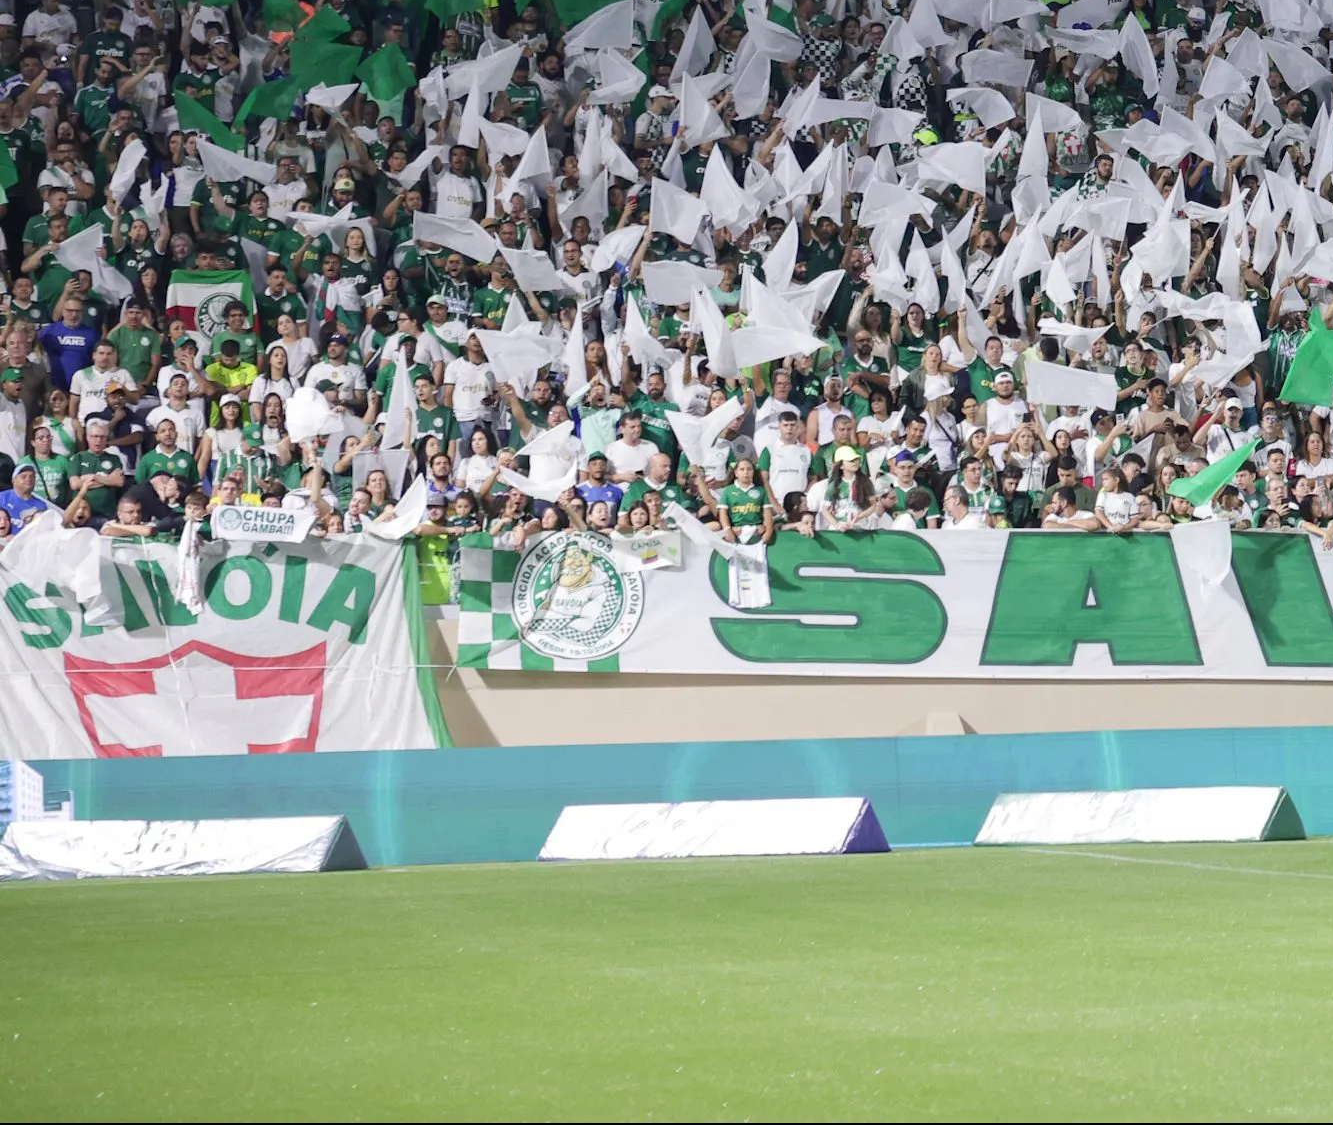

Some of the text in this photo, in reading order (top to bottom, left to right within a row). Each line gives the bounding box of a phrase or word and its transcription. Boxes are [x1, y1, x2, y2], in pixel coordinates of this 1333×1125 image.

[57, 336, 86, 346] VANS
[243, 510, 295, 524] CHUPA
[242, 522, 294, 534] GAMBA!!!
